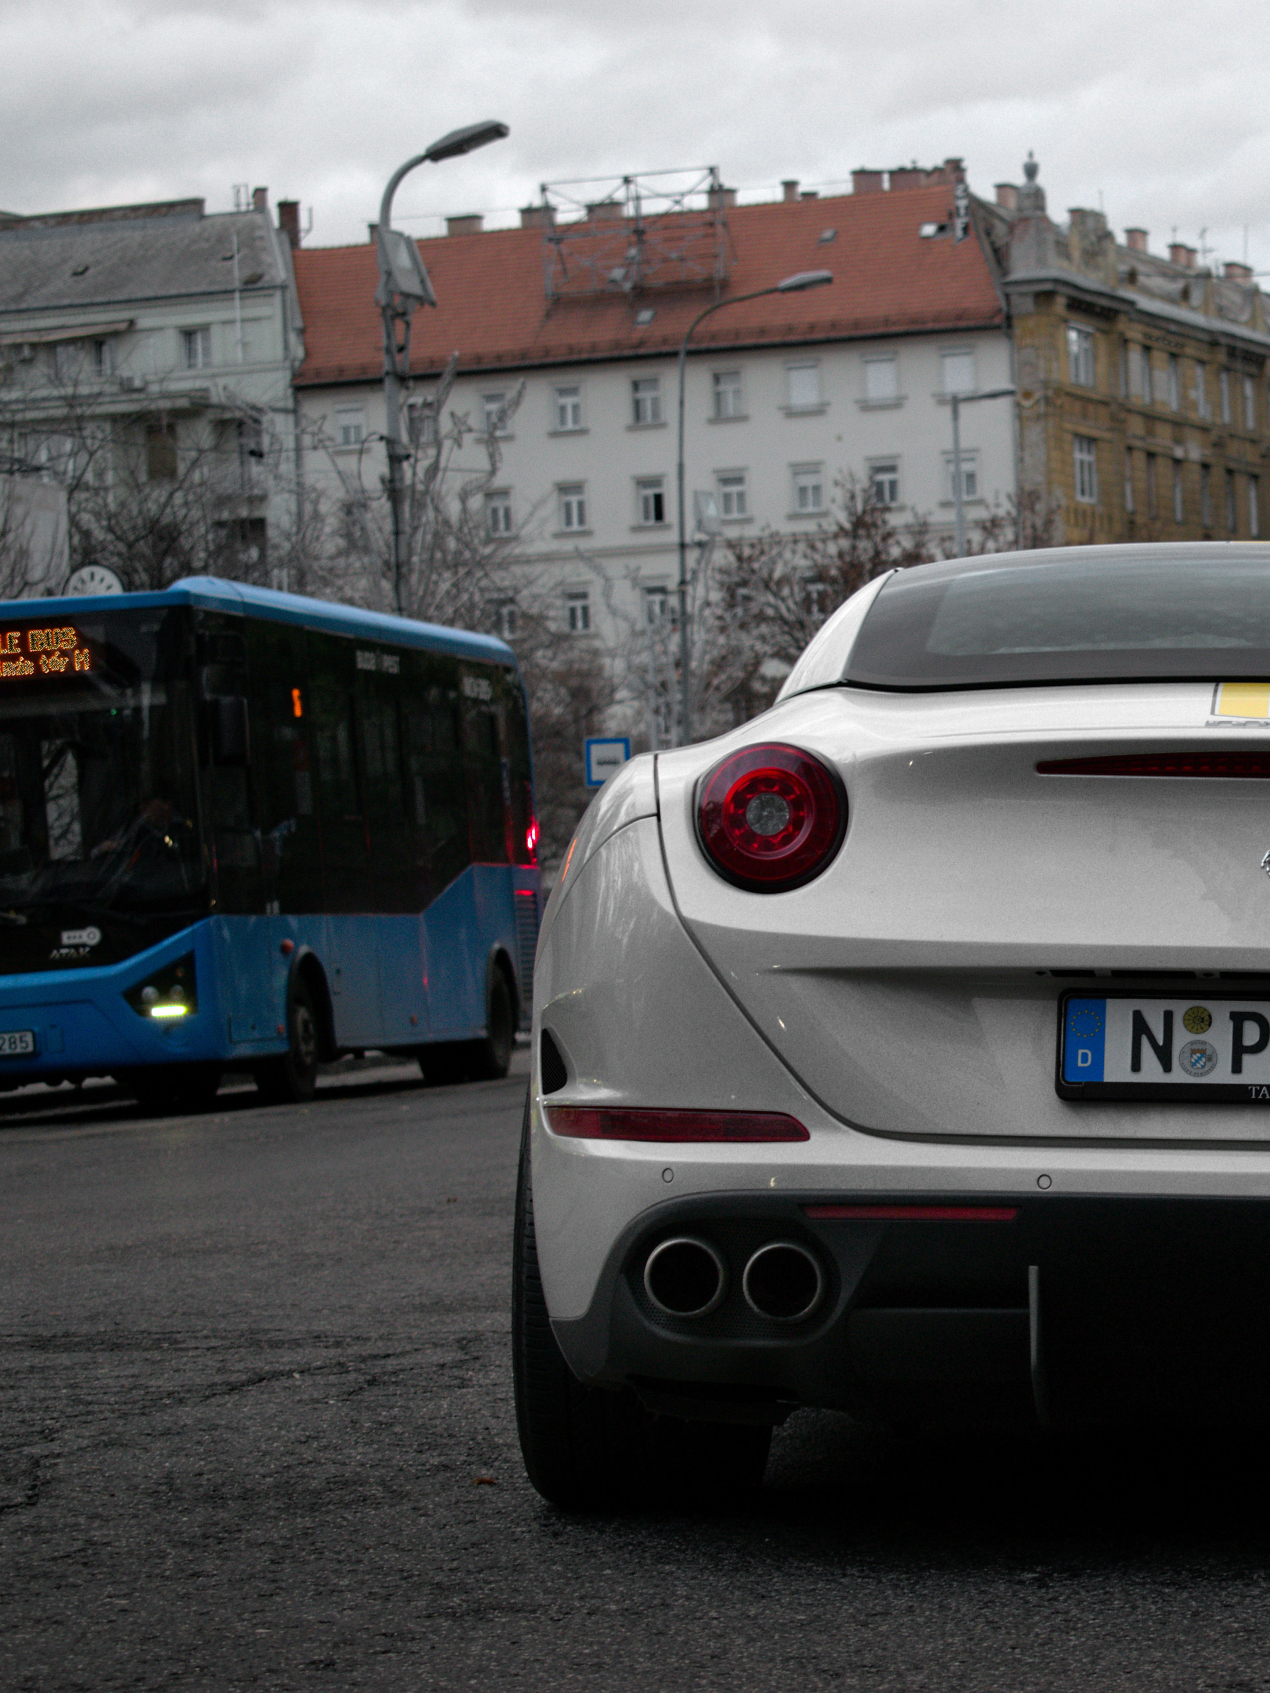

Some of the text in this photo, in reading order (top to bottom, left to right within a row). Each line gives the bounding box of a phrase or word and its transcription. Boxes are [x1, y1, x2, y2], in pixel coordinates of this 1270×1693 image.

[28, 627, 77, 652] BUS
[1131, 1009, 1174, 1073] N
[1229, 1010, 1270, 1074] P
[1077, 1049, 1092, 1068] D
